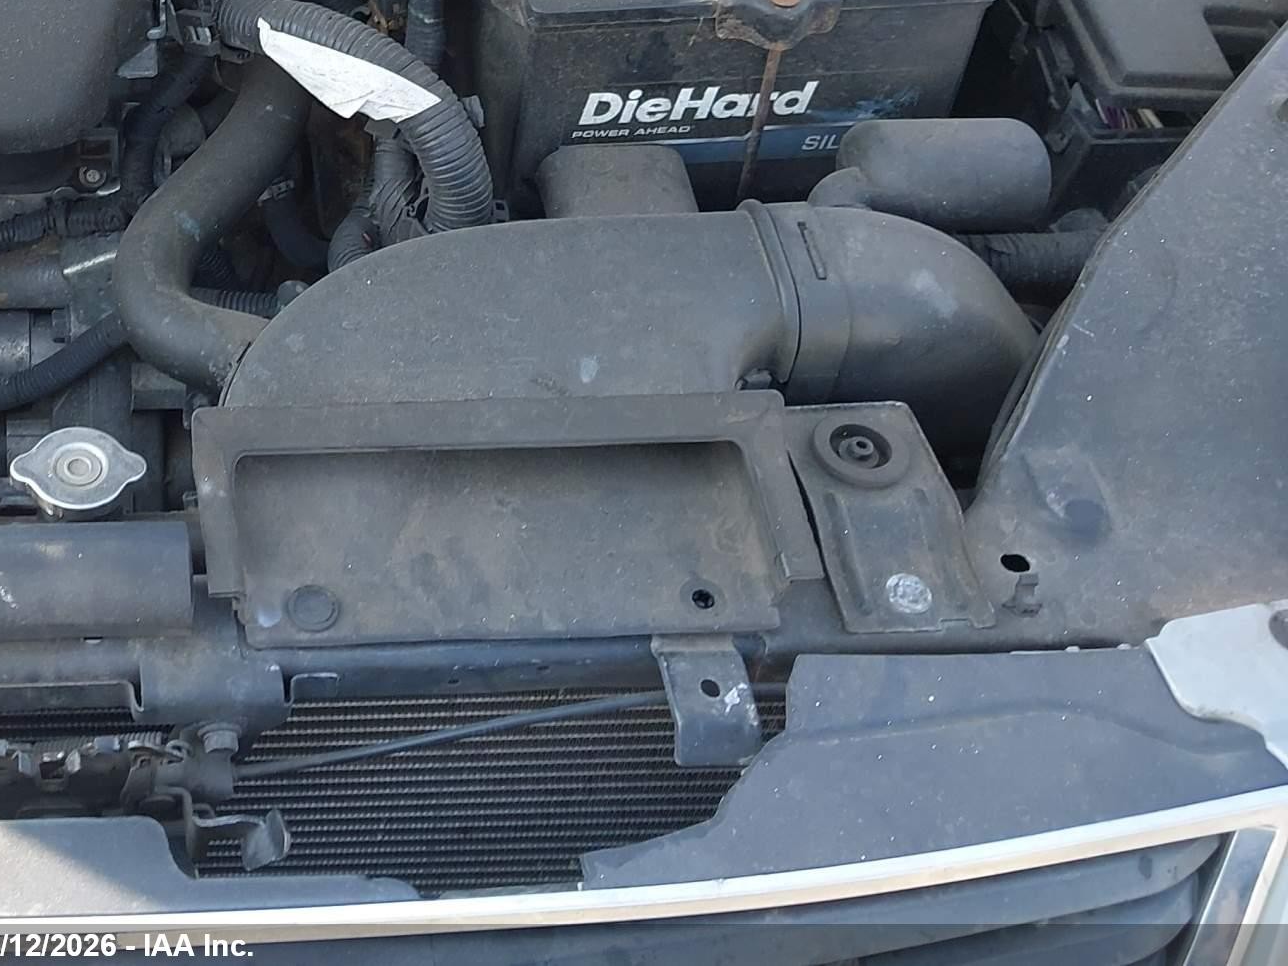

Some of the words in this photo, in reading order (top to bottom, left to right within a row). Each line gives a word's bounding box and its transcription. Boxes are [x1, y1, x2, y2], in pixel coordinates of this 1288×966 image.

[578, 80, 820, 126] DieHard
[571, 127, 630, 139] POWER
[633, 124, 692, 136] AHEAD
